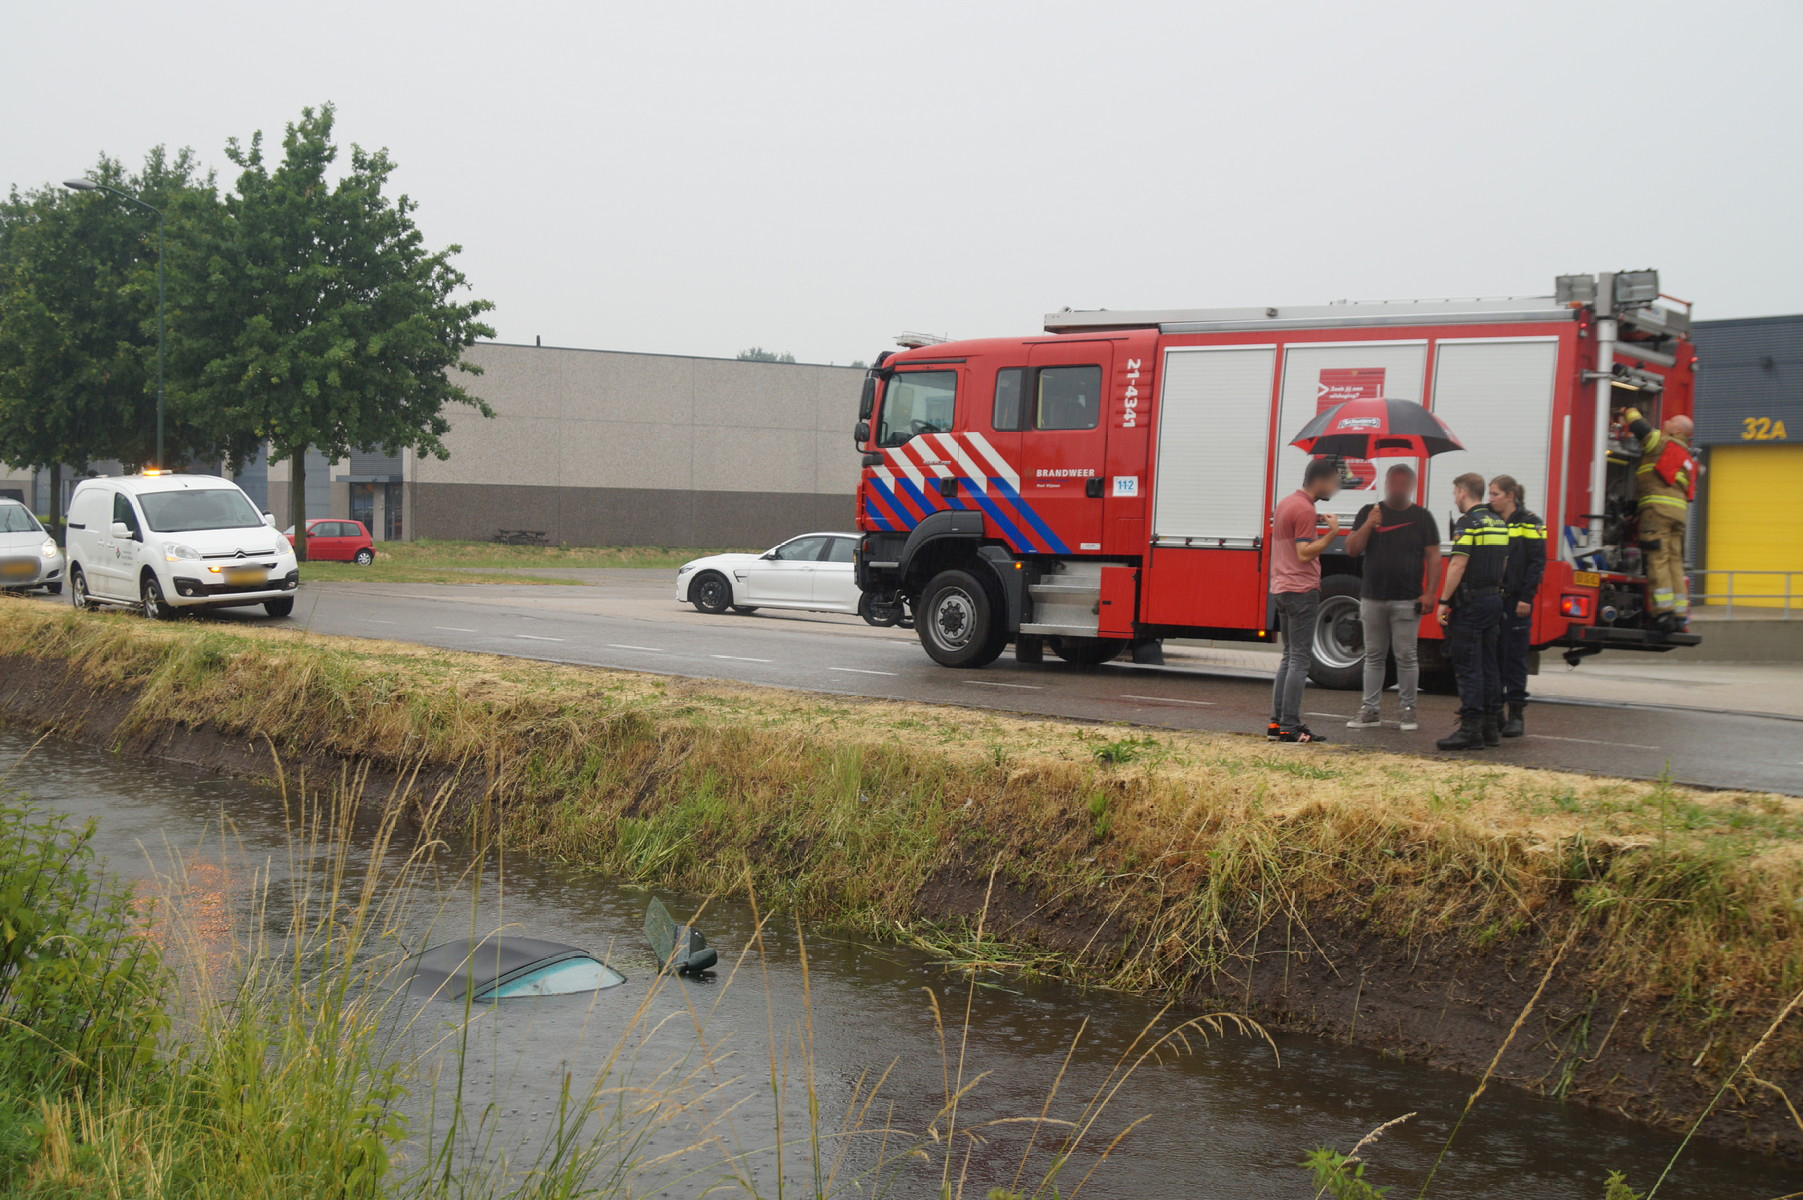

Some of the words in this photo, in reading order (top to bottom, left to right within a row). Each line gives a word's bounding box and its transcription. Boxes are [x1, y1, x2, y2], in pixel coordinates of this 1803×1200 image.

[1123, 358, 1141, 428] 21-4341
[1741, 416, 1787, 440] 32A
[1036, 469, 1095, 477] BRANDWEER
